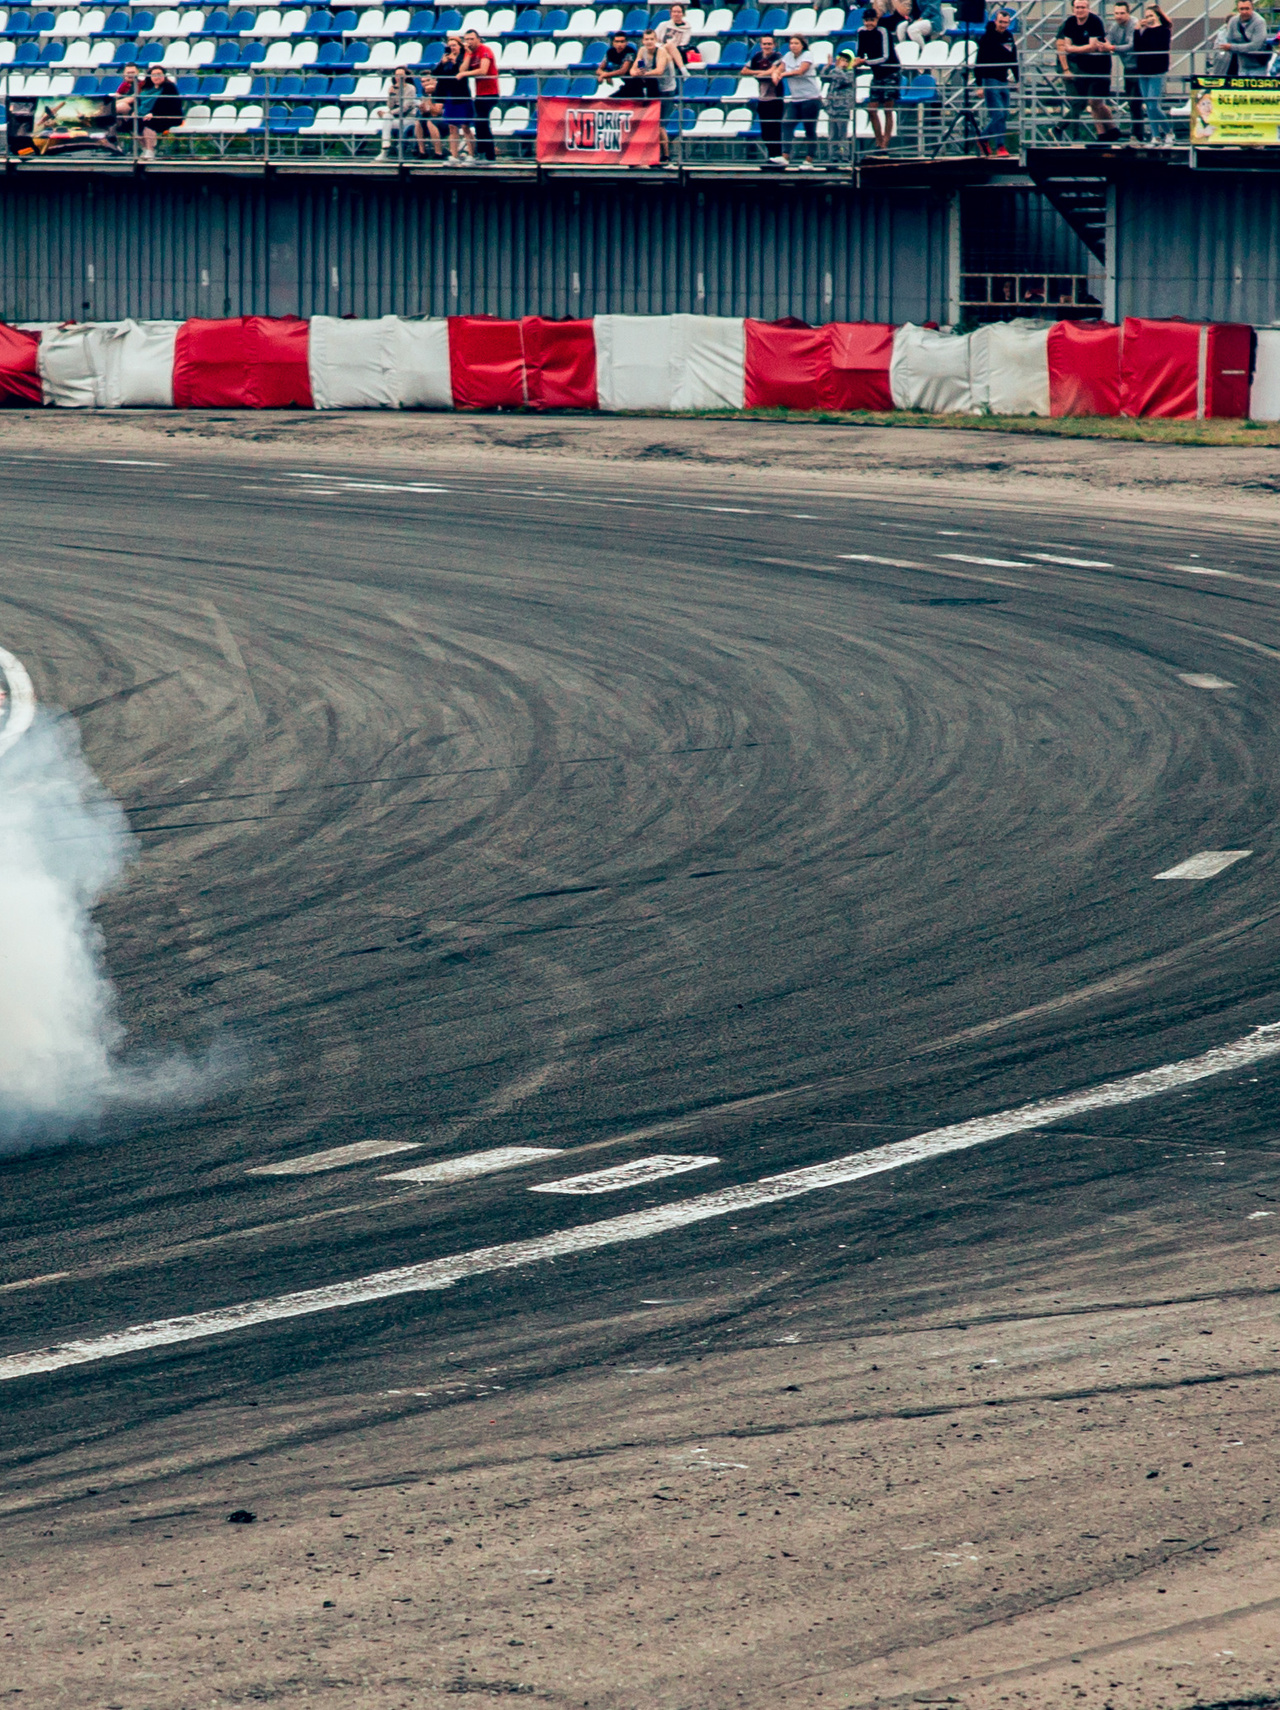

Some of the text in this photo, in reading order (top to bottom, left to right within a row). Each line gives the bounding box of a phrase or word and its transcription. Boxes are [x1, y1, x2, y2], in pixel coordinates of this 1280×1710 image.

[1231, 78, 1280, 88] АВТОЗАП
[596, 110, 634, 131] DRIFT
[596, 131, 621, 151] FUN
